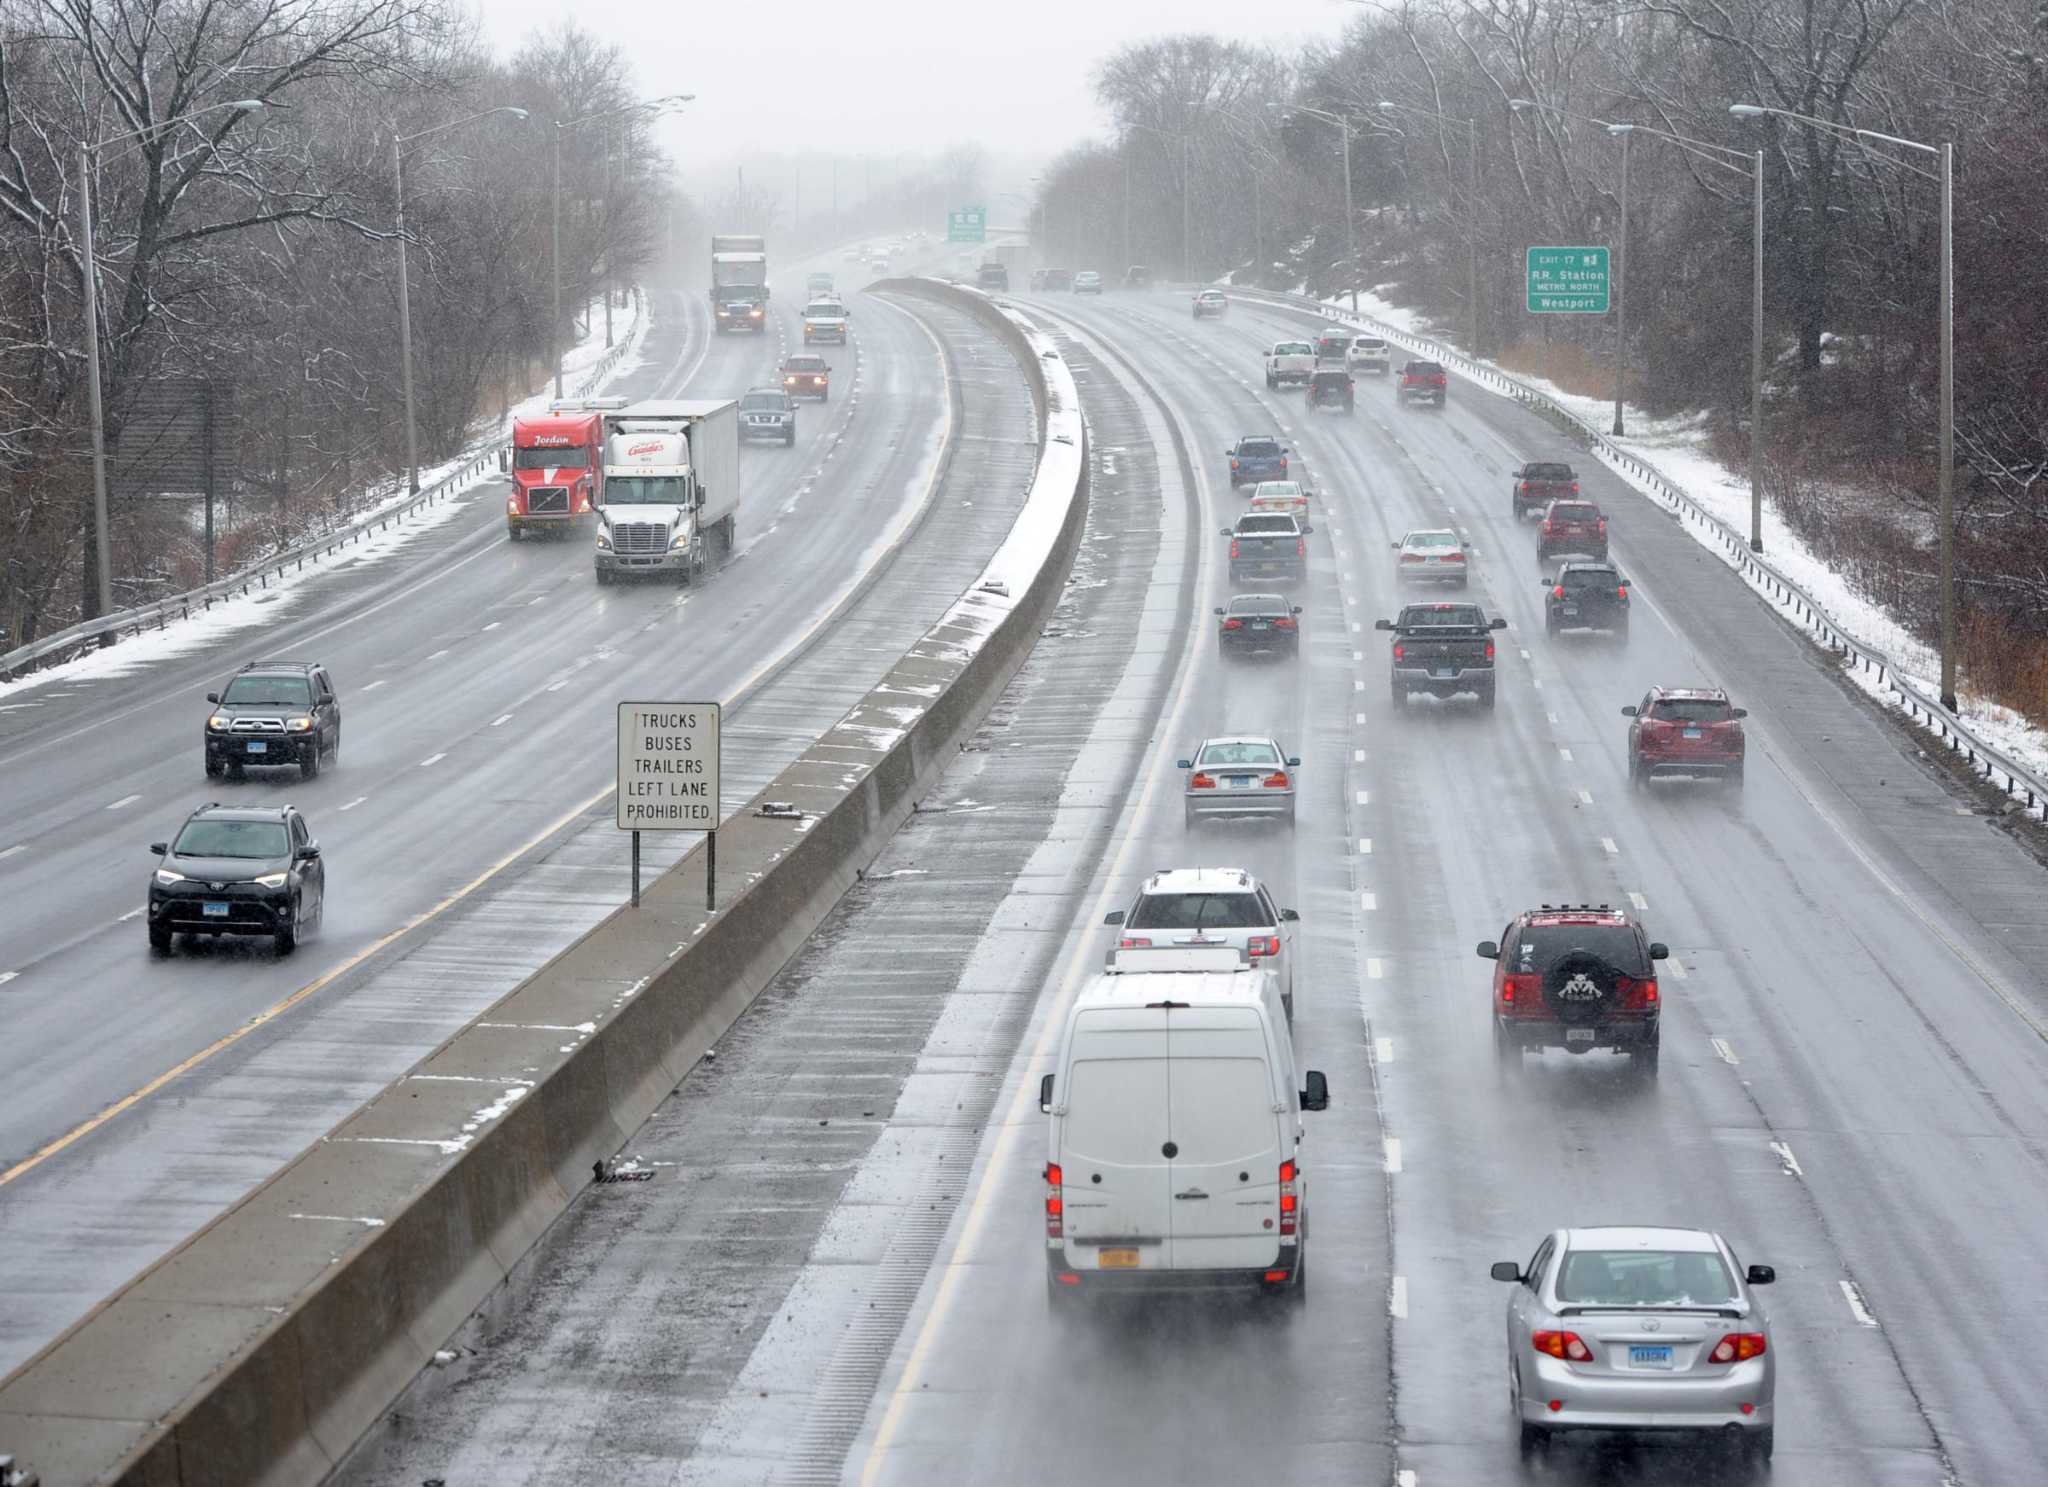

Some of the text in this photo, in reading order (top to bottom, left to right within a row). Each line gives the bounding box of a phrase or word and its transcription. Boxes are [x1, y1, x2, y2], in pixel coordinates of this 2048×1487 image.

[1539, 255, 1575, 264] EXIT 17
[1532, 270, 1605, 280] R.R. Station
[1537, 283, 1600, 291] METRO NORTH
[1540, 298, 1596, 309] Westport
[534, 434, 570, 446] Jordan
[642, 713, 697, 728] TRUCKS
[645, 736, 692, 751] BUSES
[635, 759, 703, 774] TRAILERS
[628, 782, 709, 796] LEFT LANE
[627, 804, 710, 819] PROHIBITED
